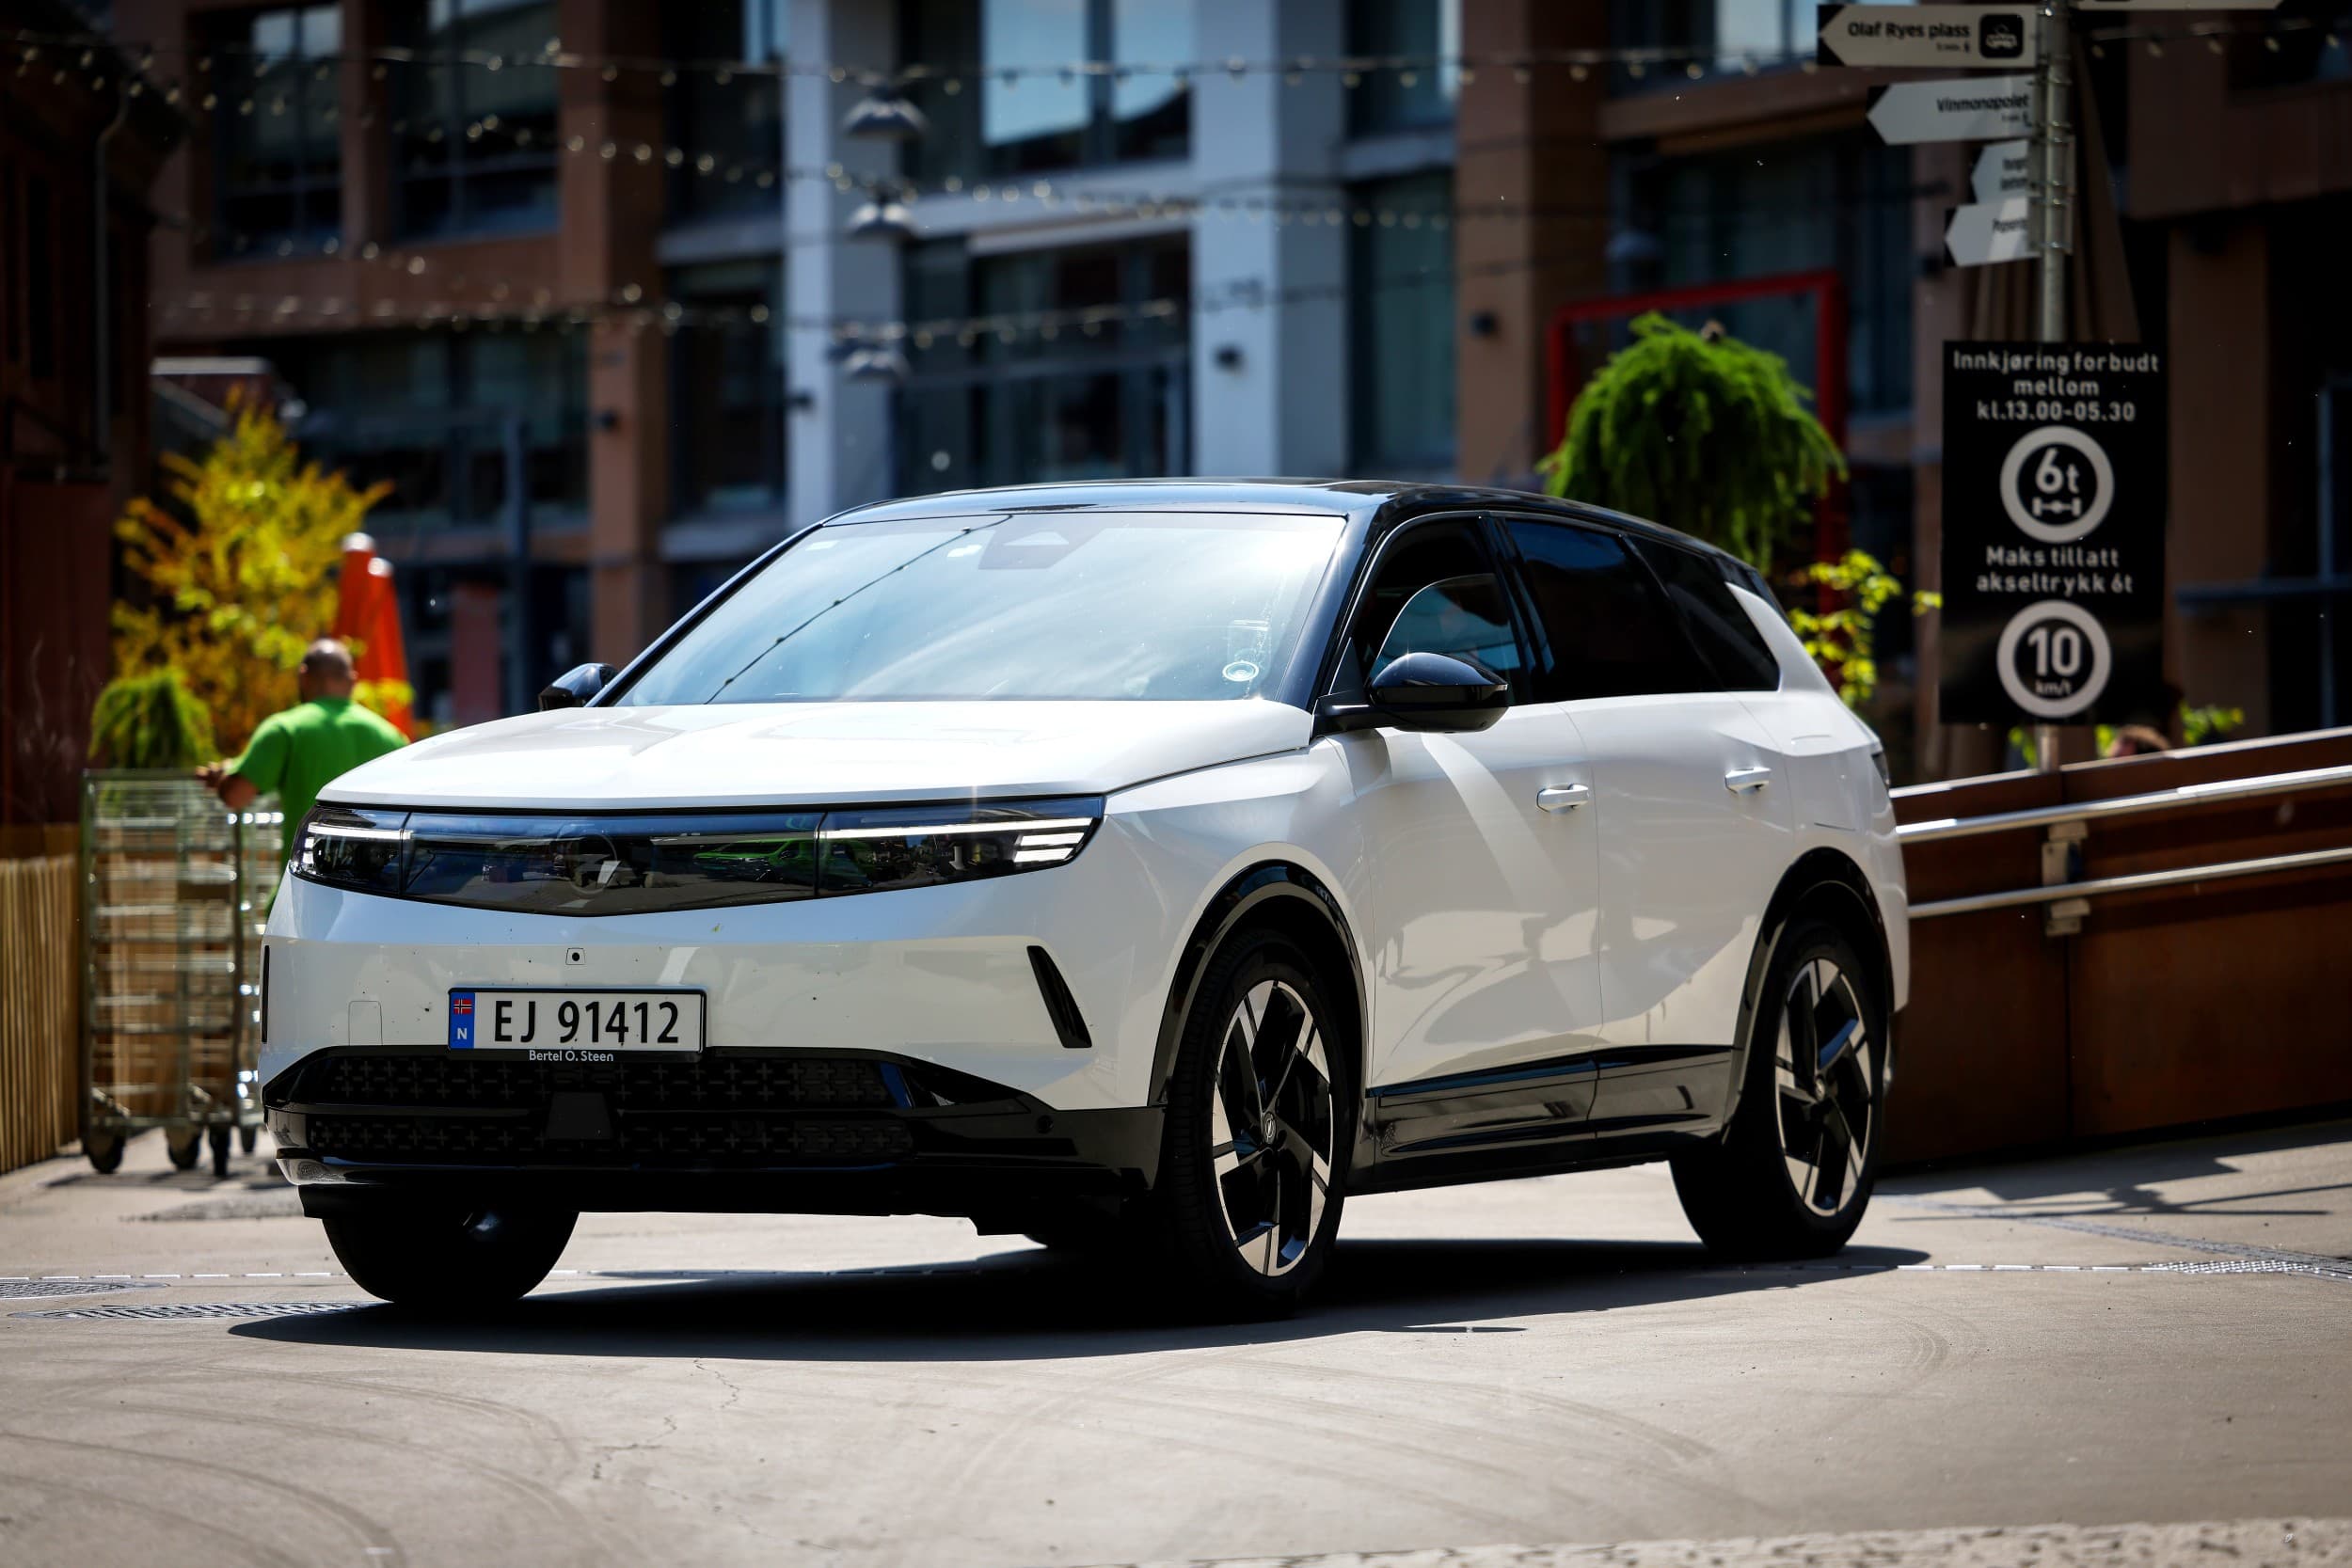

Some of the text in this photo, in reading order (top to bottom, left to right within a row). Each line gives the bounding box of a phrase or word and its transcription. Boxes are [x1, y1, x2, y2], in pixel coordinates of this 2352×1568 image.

[1848, 22, 1971, 40] Olaf Ryes plass
[1936, 93, 2029, 112] Vinmonopolet
[1953, 350, 2159, 375] Innkjøring forbudt
[2013, 376, 2100, 397] mellom
[2034, 447, 2080, 495] 6t
[1986, 546, 2120, 567] Maks tillatt
[1976, 572, 2134, 597] akseltrykk 6t
[2027, 626, 2082, 677] 10
[2035, 679, 2074, 697] km/t
[494, 1000, 679, 1044] EJ 91412
[456, 1027, 468, 1040] N
[529, 1050, 614, 1062] Bertel O. Steen
